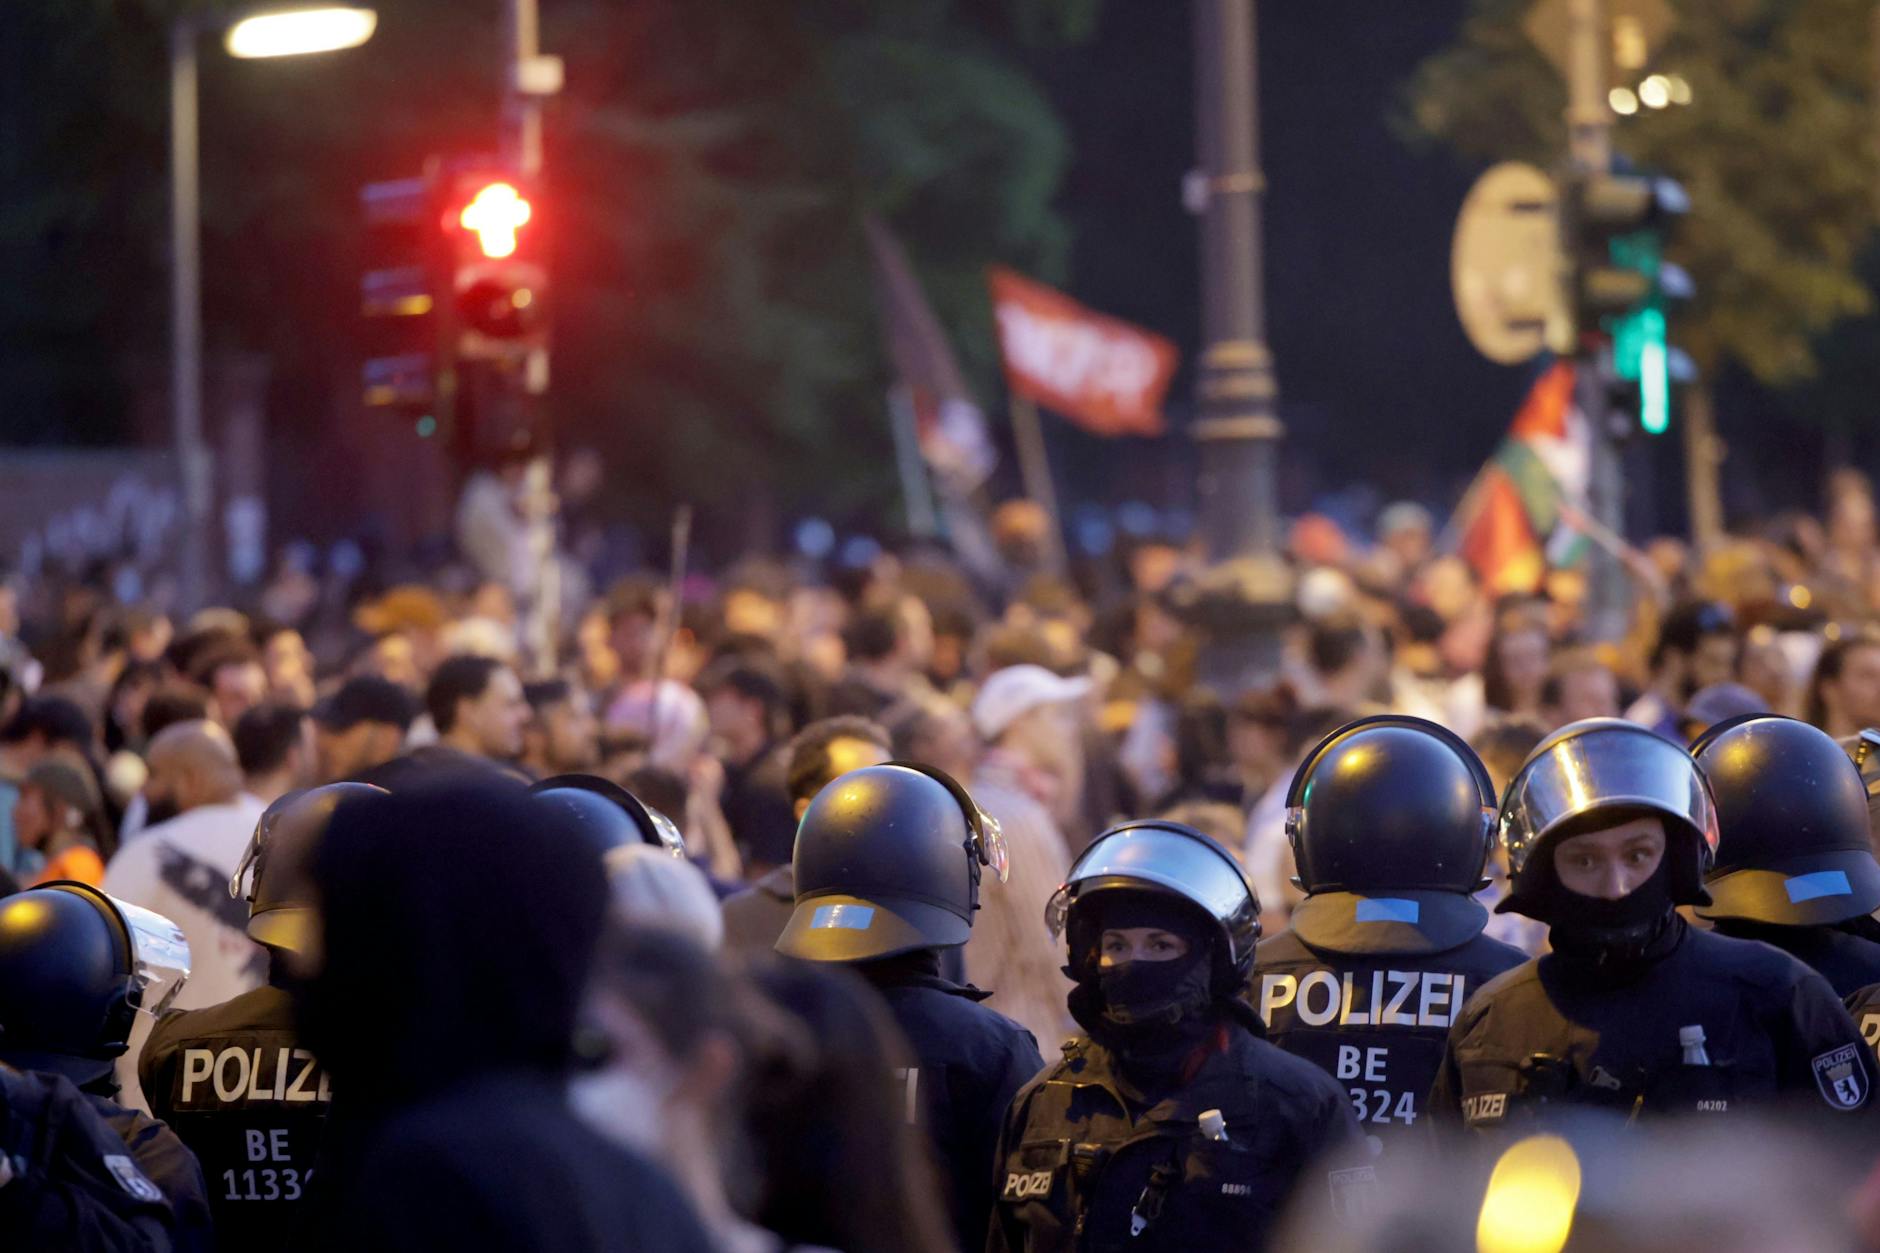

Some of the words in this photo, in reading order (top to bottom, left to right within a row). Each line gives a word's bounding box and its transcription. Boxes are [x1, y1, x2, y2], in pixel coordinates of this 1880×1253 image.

[1259, 969, 1466, 1028] POLIZEI
[1336, 1044, 1389, 1082] BE
[1815, 1046, 1856, 1072] POLIZEI
[245, 1128, 292, 1162] BE
[223, 1168, 315, 1201] 1133
